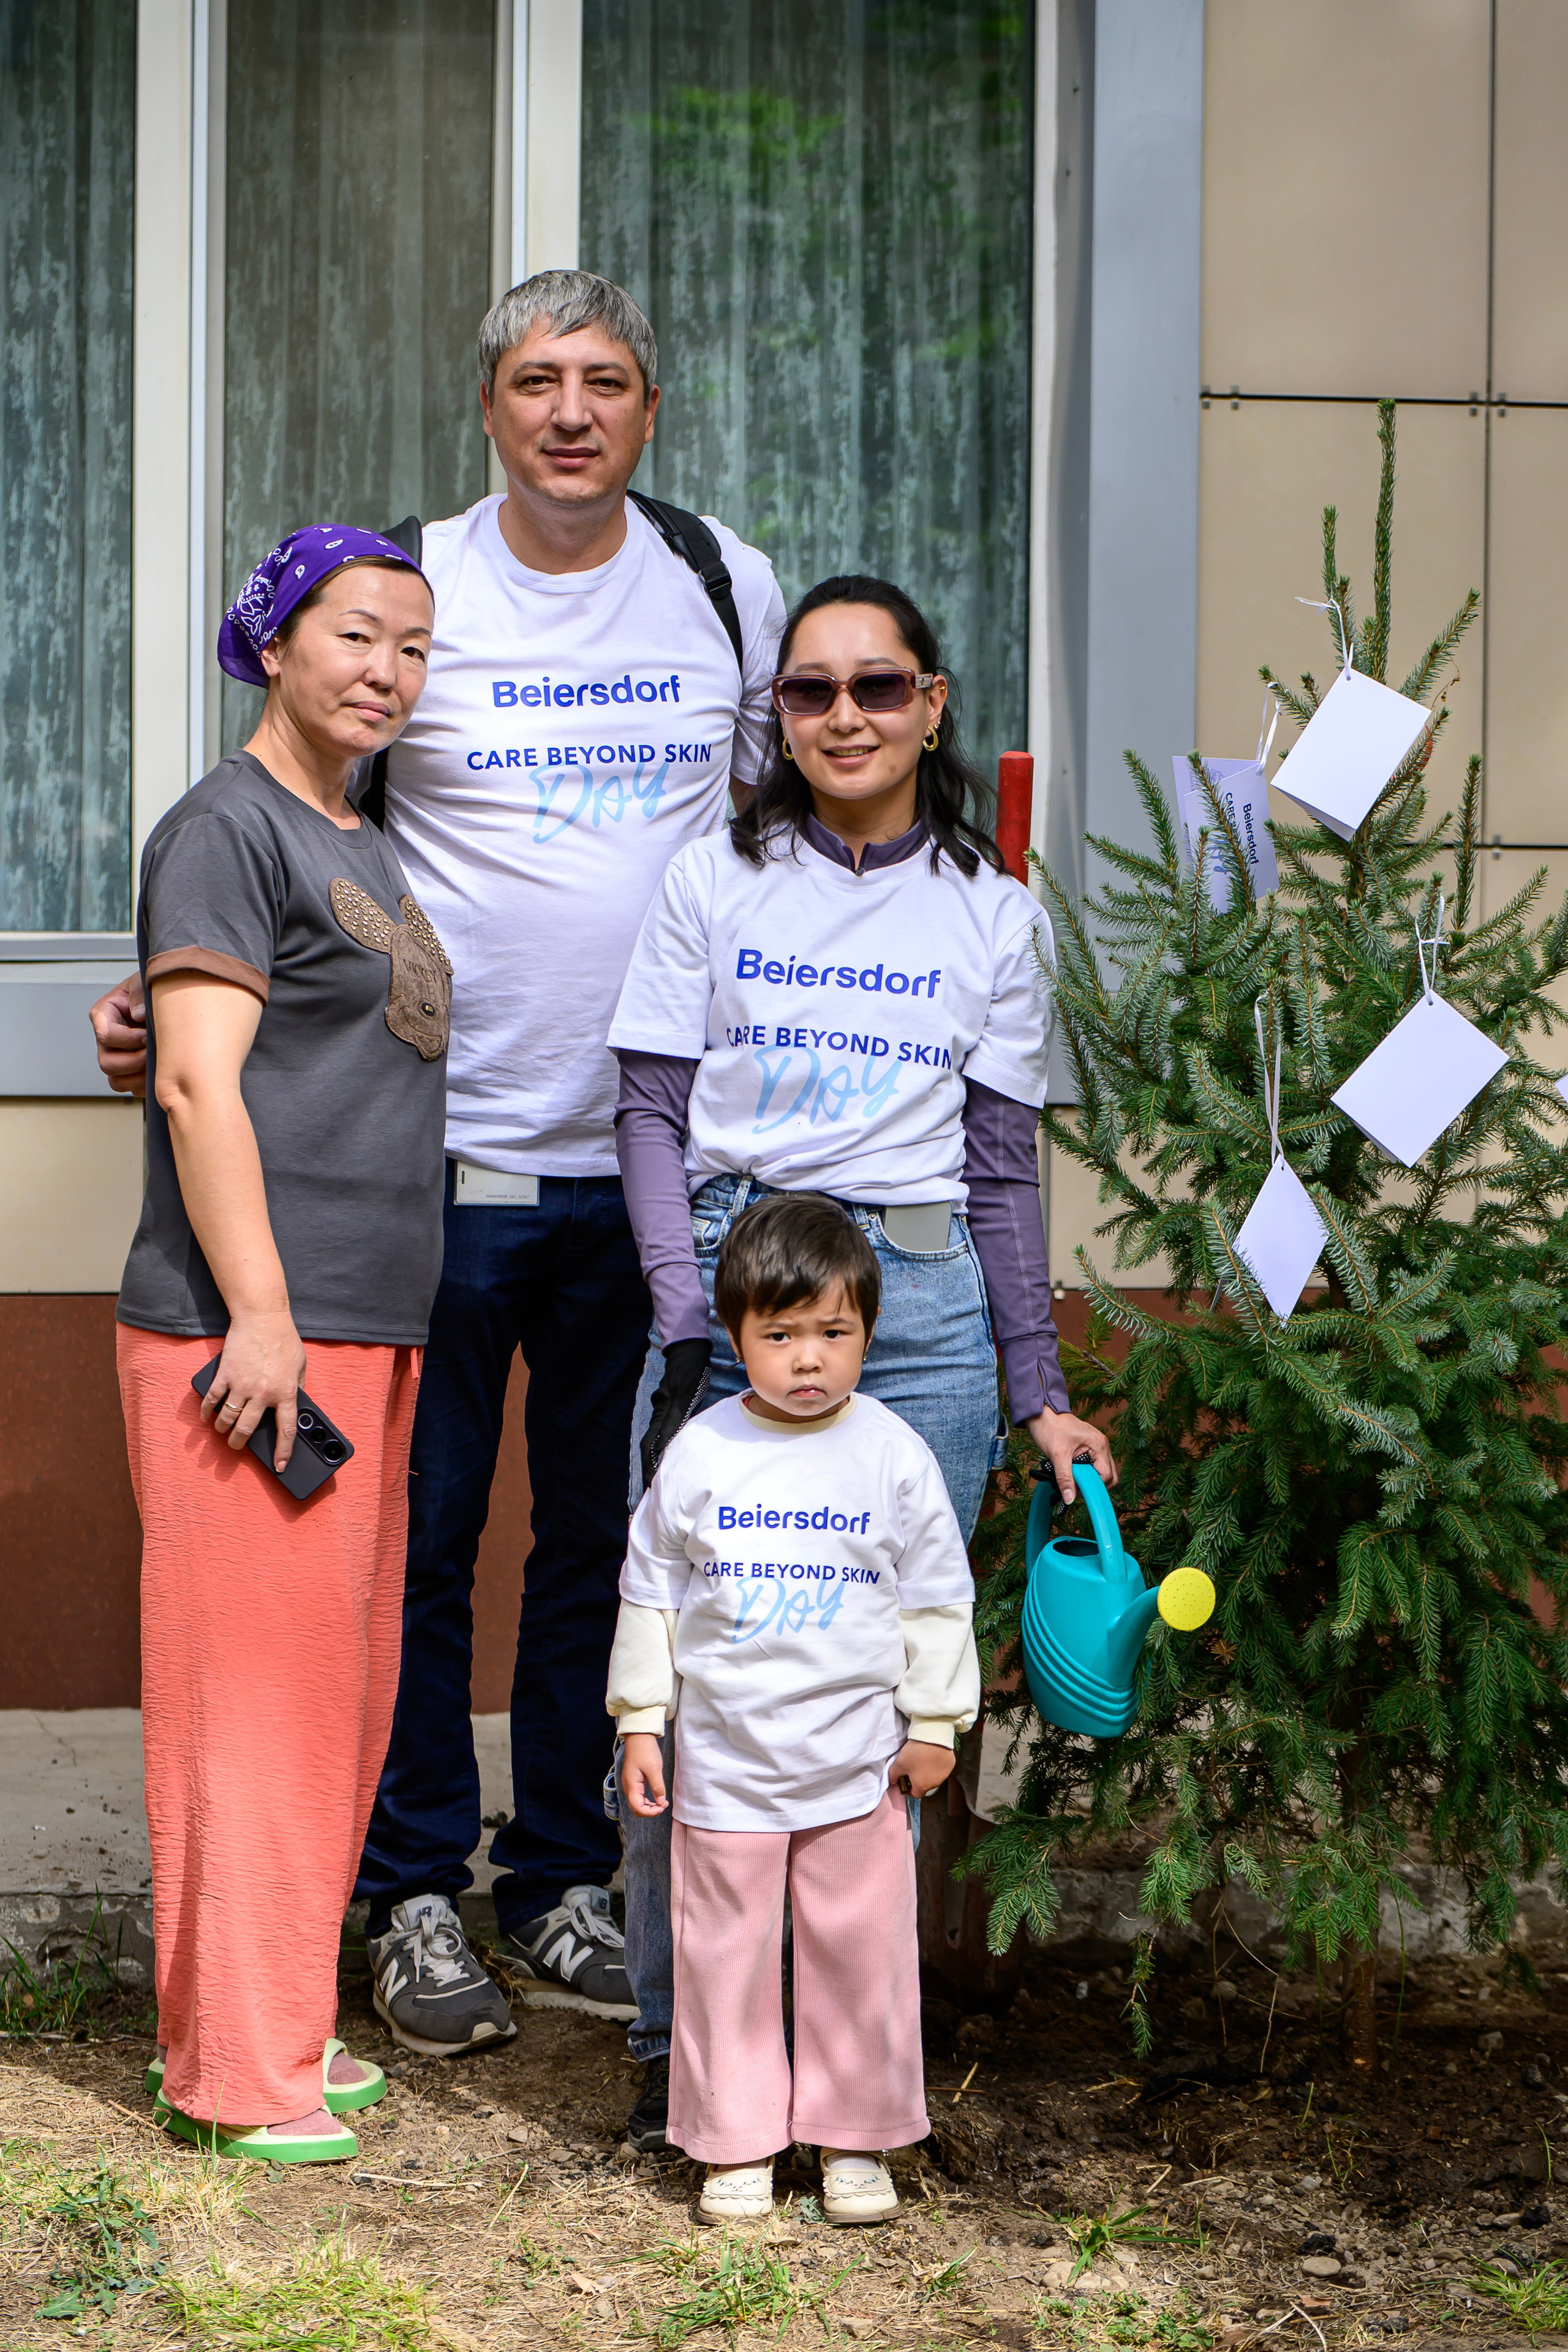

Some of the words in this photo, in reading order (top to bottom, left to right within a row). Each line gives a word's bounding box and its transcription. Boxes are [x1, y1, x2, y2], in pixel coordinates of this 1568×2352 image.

[492, 674, 680, 708] Beiersdorf
[467, 748, 538, 771] CARE
[547, 744, 656, 766] BEYOND
[665, 744, 712, 763] SKIN
[1243, 802, 1259, 864] Beiersdorf
[736, 948, 941, 998] Beiersdorf
[726, 1025, 766, 1048] CARE
[775, 1027, 889, 1057] BEYOND
[897, 1041, 952, 1071] SKIN
[718, 1503, 871, 1536] Beiersdorf
[703, 1562, 744, 1578] CARE
[750, 1562, 836, 1580] BEYOND
[841, 1567, 881, 1585] SKIN
[543, 1931, 595, 1983] N
[379, 1956, 410, 2009] N
